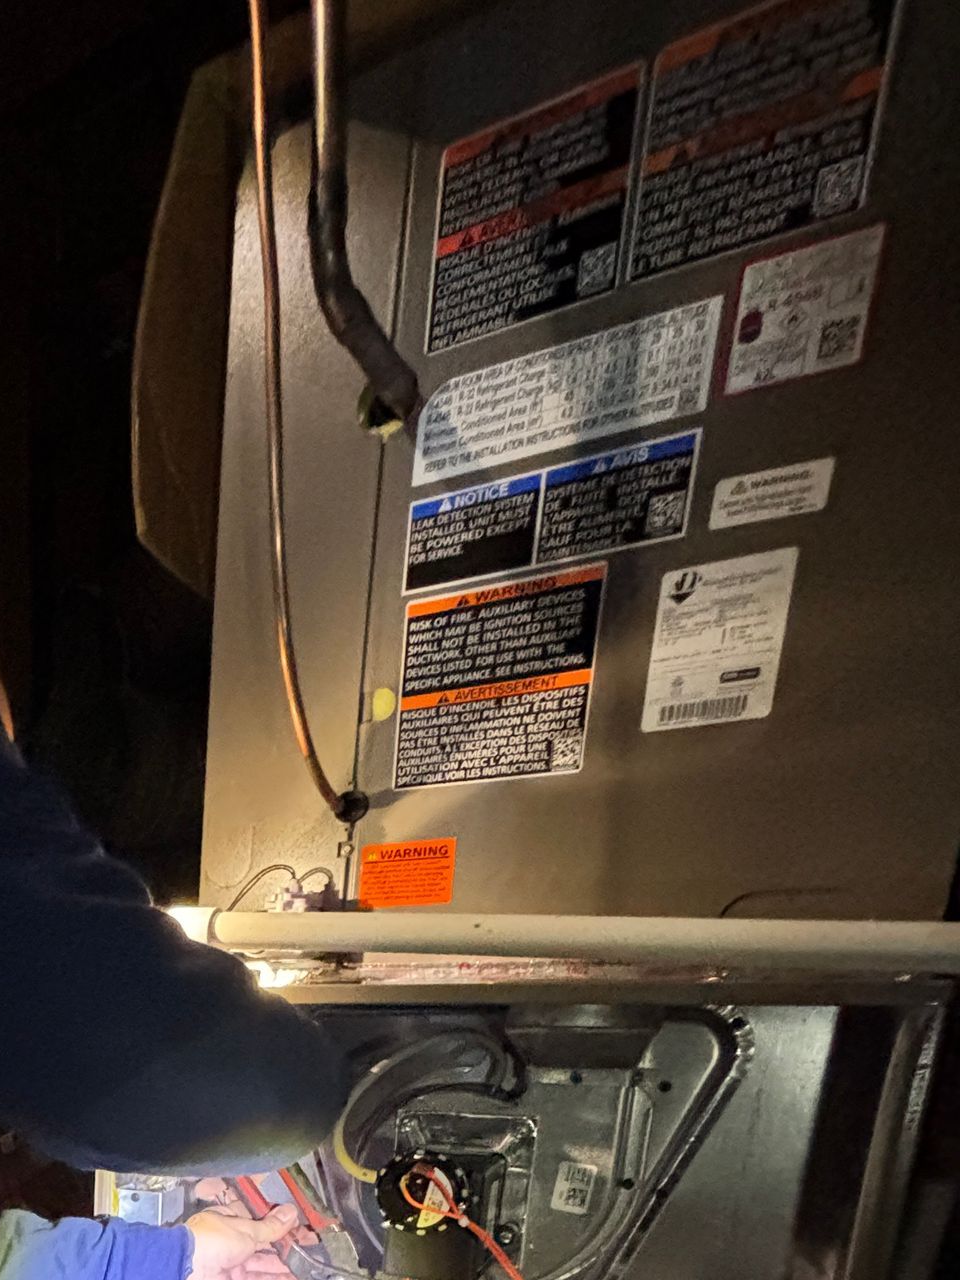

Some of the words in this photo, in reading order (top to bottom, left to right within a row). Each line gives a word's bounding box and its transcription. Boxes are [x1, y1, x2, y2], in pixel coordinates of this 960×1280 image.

[610, 447, 650, 471] AVIS
[454, 482, 510, 508] NOTICE
[545, 501, 560, 513] DE
[412, 519, 434, 532] LEAK
[437, 505, 492, 527] DETECTION
[495, 493, 535, 511] SYSTEM
[469, 514, 495, 527] UNIT
[498, 506, 530, 520] MUST
[410, 543, 423, 554] BE
[427, 528, 484, 549] POWERED
[487, 516, 531, 536] EXCEPT
[409, 553, 425, 564] FOR
[476, 577, 557, 603] WARNING
[409, 629, 442, 643] WHICH
[445, 625, 467, 637] MAY
[469, 622, 481, 632] BE
[484, 612, 532, 629] IGNITION
[533, 602, 584, 621] SOURCES
[410, 619, 432, 631] RISK
[434, 617, 448, 628] OF
[478, 600, 535, 618] AUXILIARY
[537, 588, 585, 607] DEVICES
[408, 641, 439, 656] SHALL
[442, 637, 464, 648] NOT
[467, 634, 480, 644] BE
[483, 622, 541, 642] INSTALLED
[543, 620, 556, 629] IN
[560, 615, 581, 627] THE
[465, 644, 497, 656] OTHER
[500, 638, 528, 650] THAN
[529, 627, 582, 645] AUXILIARY
[406, 663, 441, 678] DEVICES
[442, 660, 473, 672] LISTED
[475, 655, 494, 666] FOR
[496, 651, 515, 663] USE
[516, 647, 542, 659] WITH
[547, 642, 565, 655] THE
[405, 678, 441, 691] SPECIFIC
[495, 665, 511, 677] SEE
[454, 676, 557, 701] AVERTISSEMENT
[402, 709, 437, 720] RISQUE
[501, 695, 519, 706] LES
[521, 686, 585, 703] DISPOSITIFS
[402, 716, 459, 730] AUXILIAIRES
[461, 712, 480, 721] QUI
[483, 704, 530, 719] PEUVENT
[533, 700, 560, 712] ÊTRE
[562, 697, 584, 708] DES
[400, 727, 439, 740] SOURCES
[522, 714, 536, 724] NE
[537, 707, 581, 722] DOIVENT
[400, 741, 415, 749] PAS
[417, 736, 438, 746] ÊTRE
[486, 728, 513, 739] DANS
[514, 726, 525, 734] LE
[527, 721, 565, 734] RÉSEAU
[566, 718, 580, 728] DE
[509, 735, 526, 746] DES
[528, 728, 582, 743] DISPOSITIFS
[397, 761, 459, 776] UTILISATION
[460, 758, 488, 769] AVEC
[490, 752, 549, 766] L'APPAREIL
[398, 754, 448, 768] AUXILIAIRES
[500, 744, 526, 755] POUR
[528, 742, 548, 752] UNE
[466, 768, 481, 777] LES
[380, 844, 449, 860] WARNING
